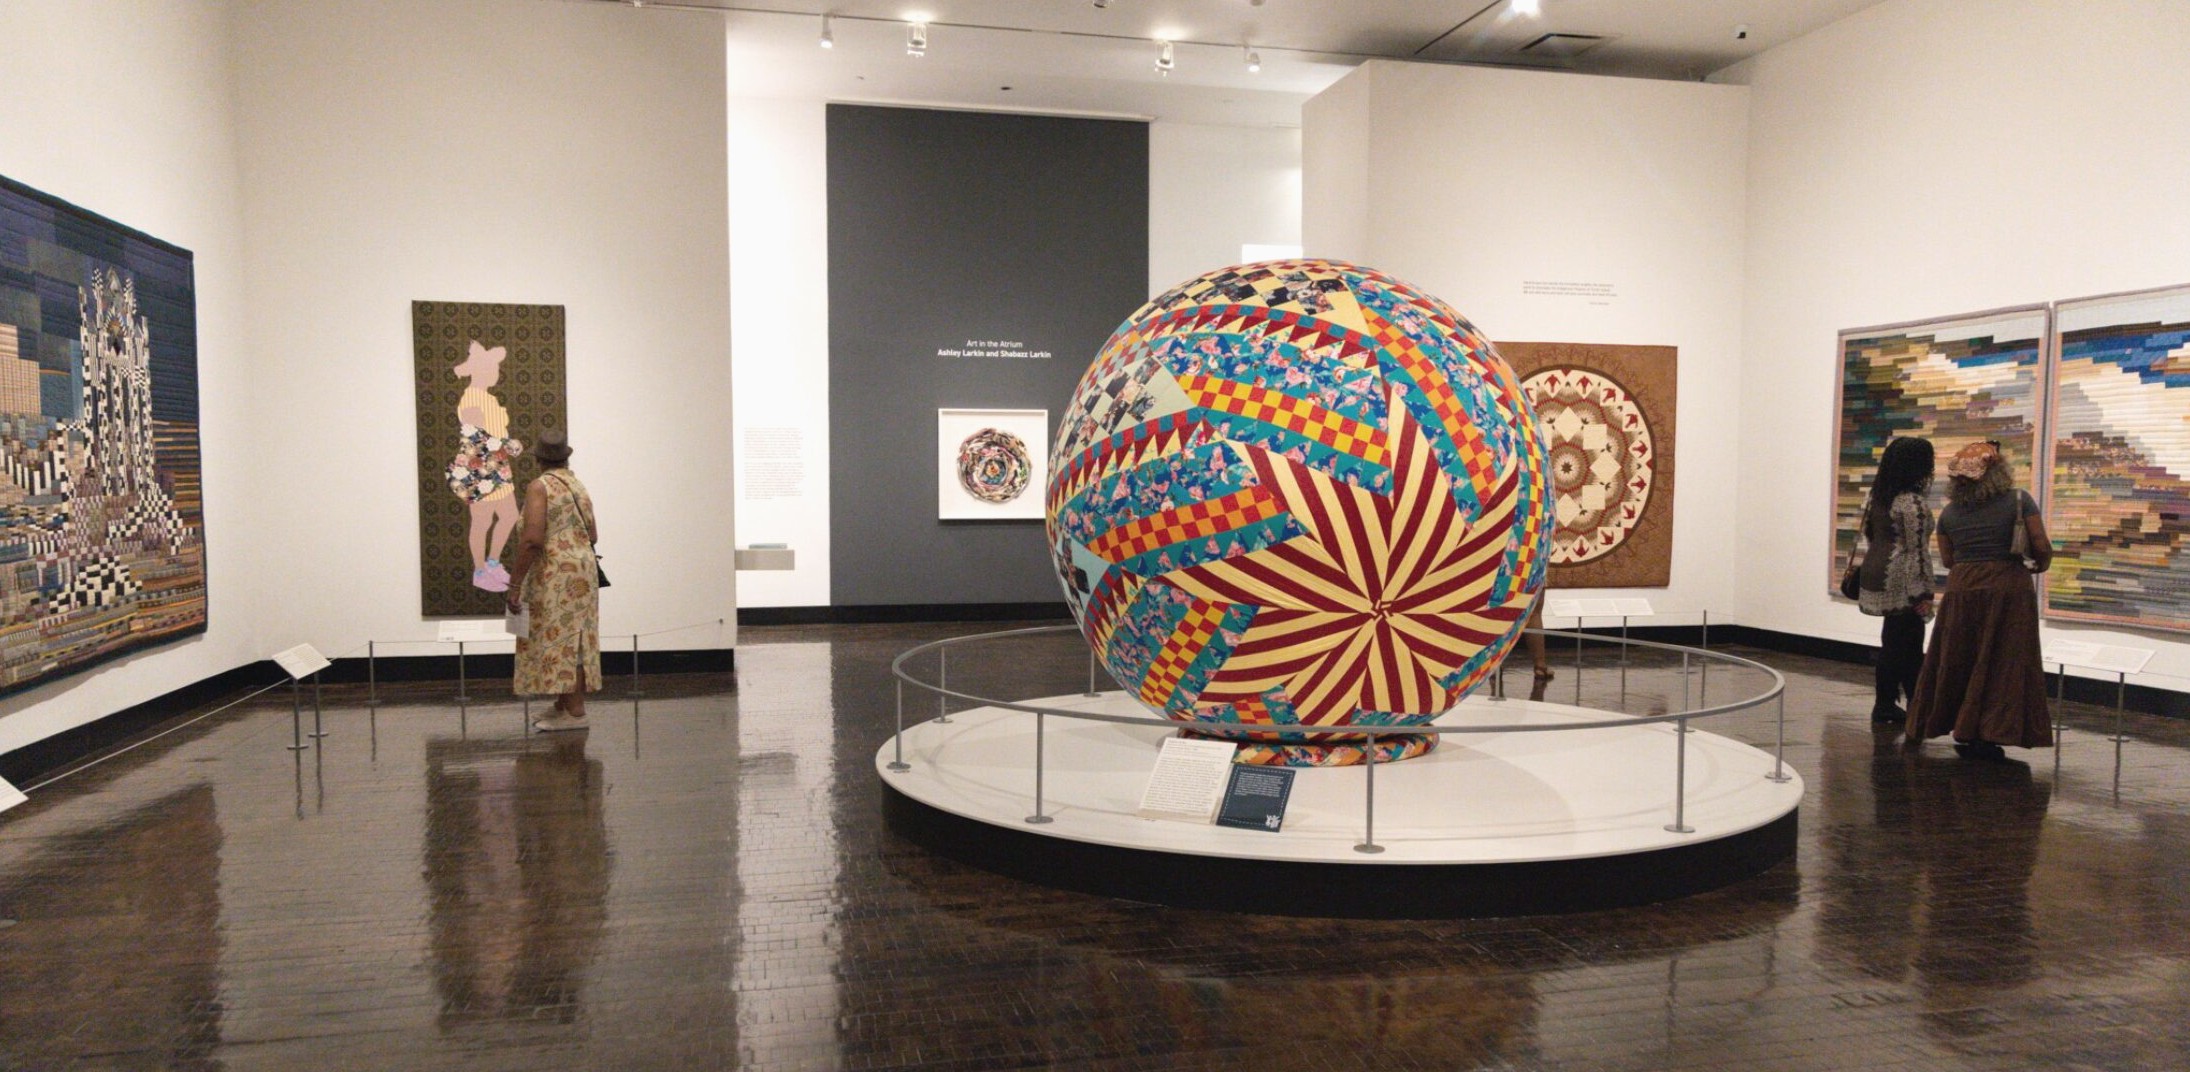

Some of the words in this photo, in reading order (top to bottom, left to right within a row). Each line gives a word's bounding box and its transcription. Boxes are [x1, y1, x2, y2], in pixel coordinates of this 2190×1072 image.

[1000, 340, 1023, 348] Atrium
[938, 349, 961, 358] Ashley
[962, 349, 985, 357] Larkin
[1000, 350, 1028, 358] Shabazz
